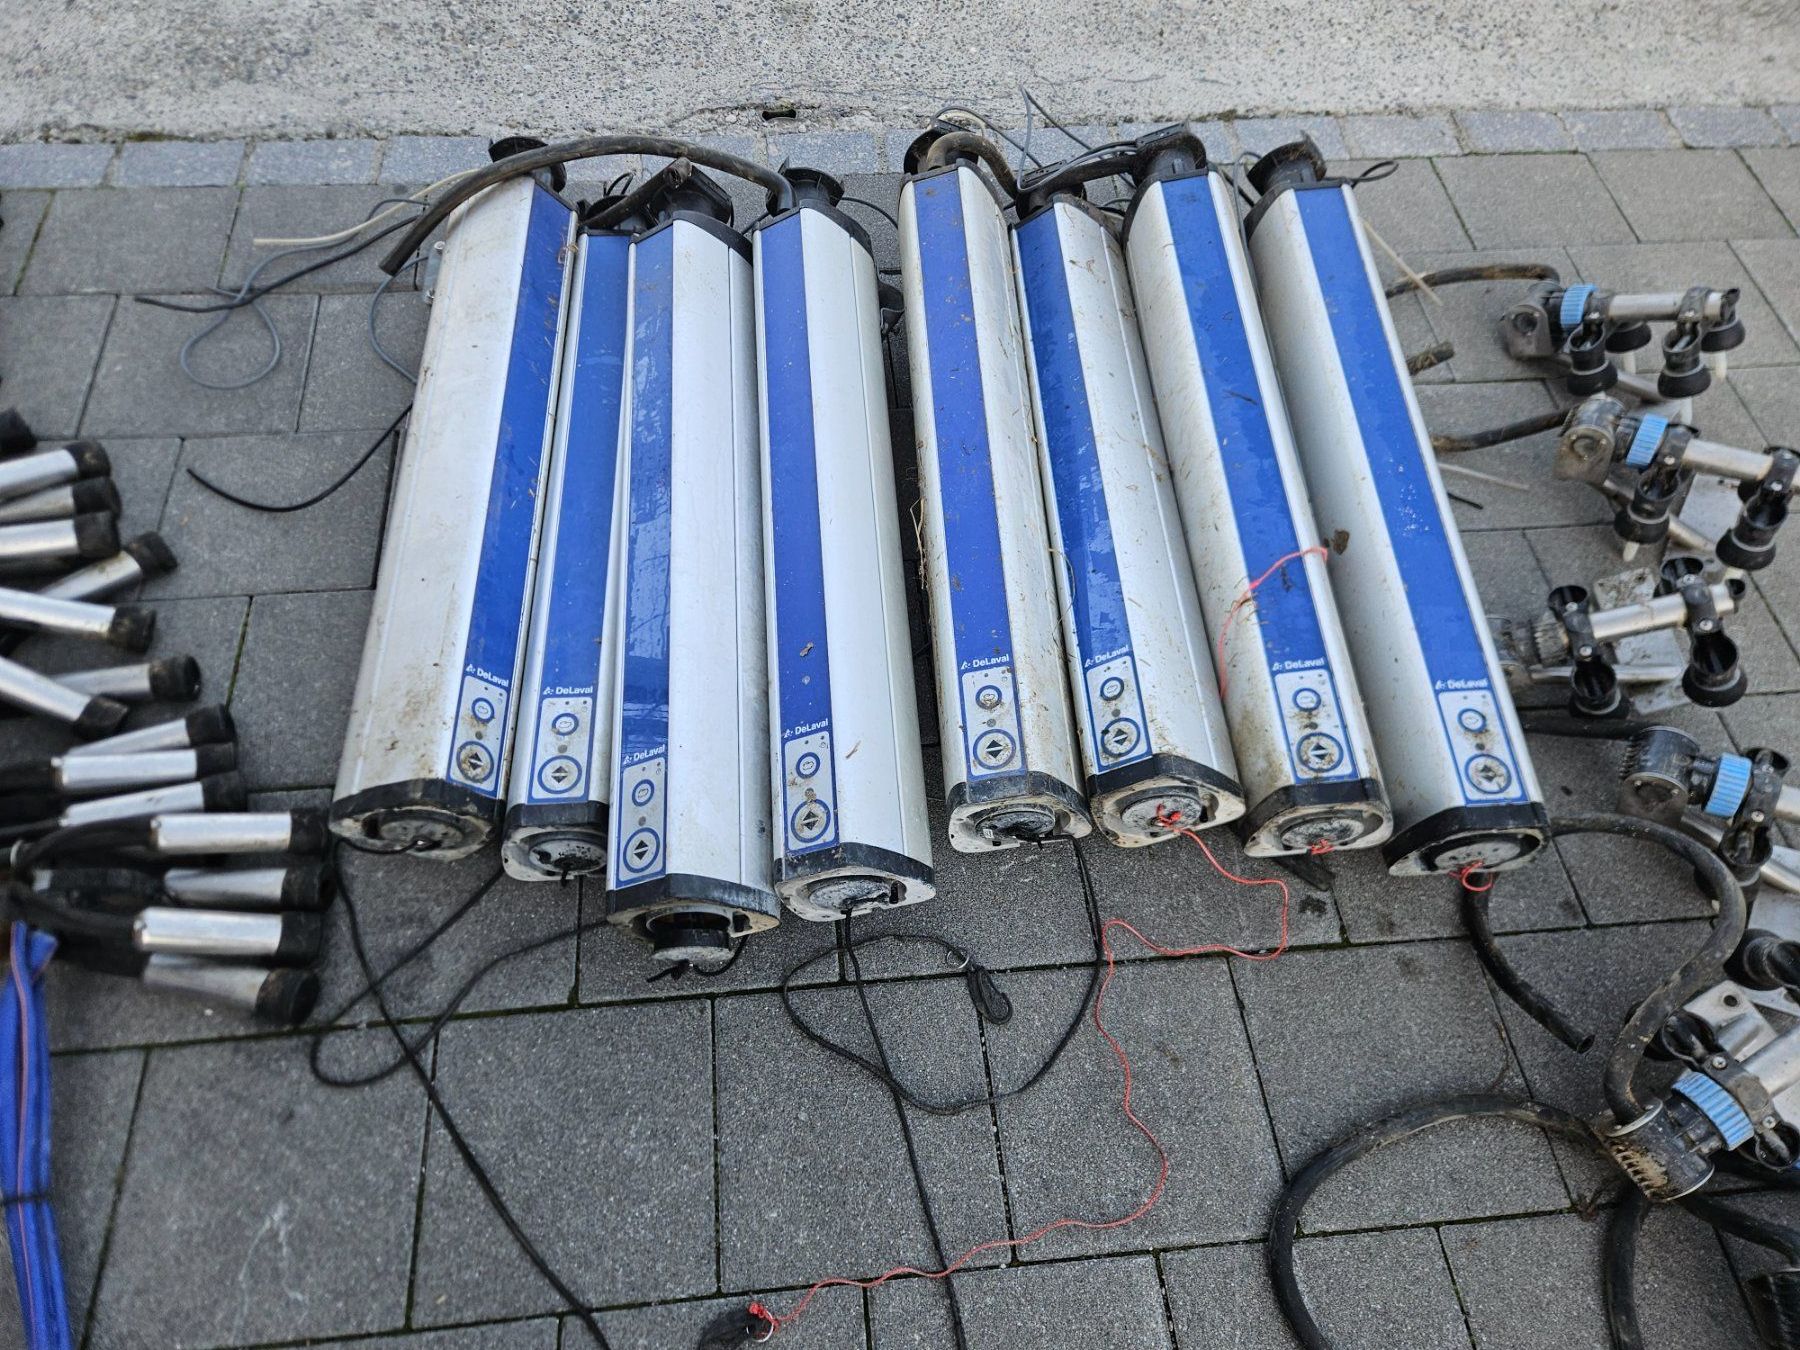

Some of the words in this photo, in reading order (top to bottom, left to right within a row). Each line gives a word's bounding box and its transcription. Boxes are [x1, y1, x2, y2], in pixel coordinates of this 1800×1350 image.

[1094, 645, 1129, 661] DeLaval
[972, 654, 1009, 668] DeLaval
[1284, 658, 1325, 671] DeLaval
[476, 667, 509, 687] DeLaval
[1447, 679, 1489, 689] DeLaval
[556, 685, 593, 695] DeLaval
[795, 718, 828, 734] DeLaval
[633, 744, 666, 761] DeLaval
